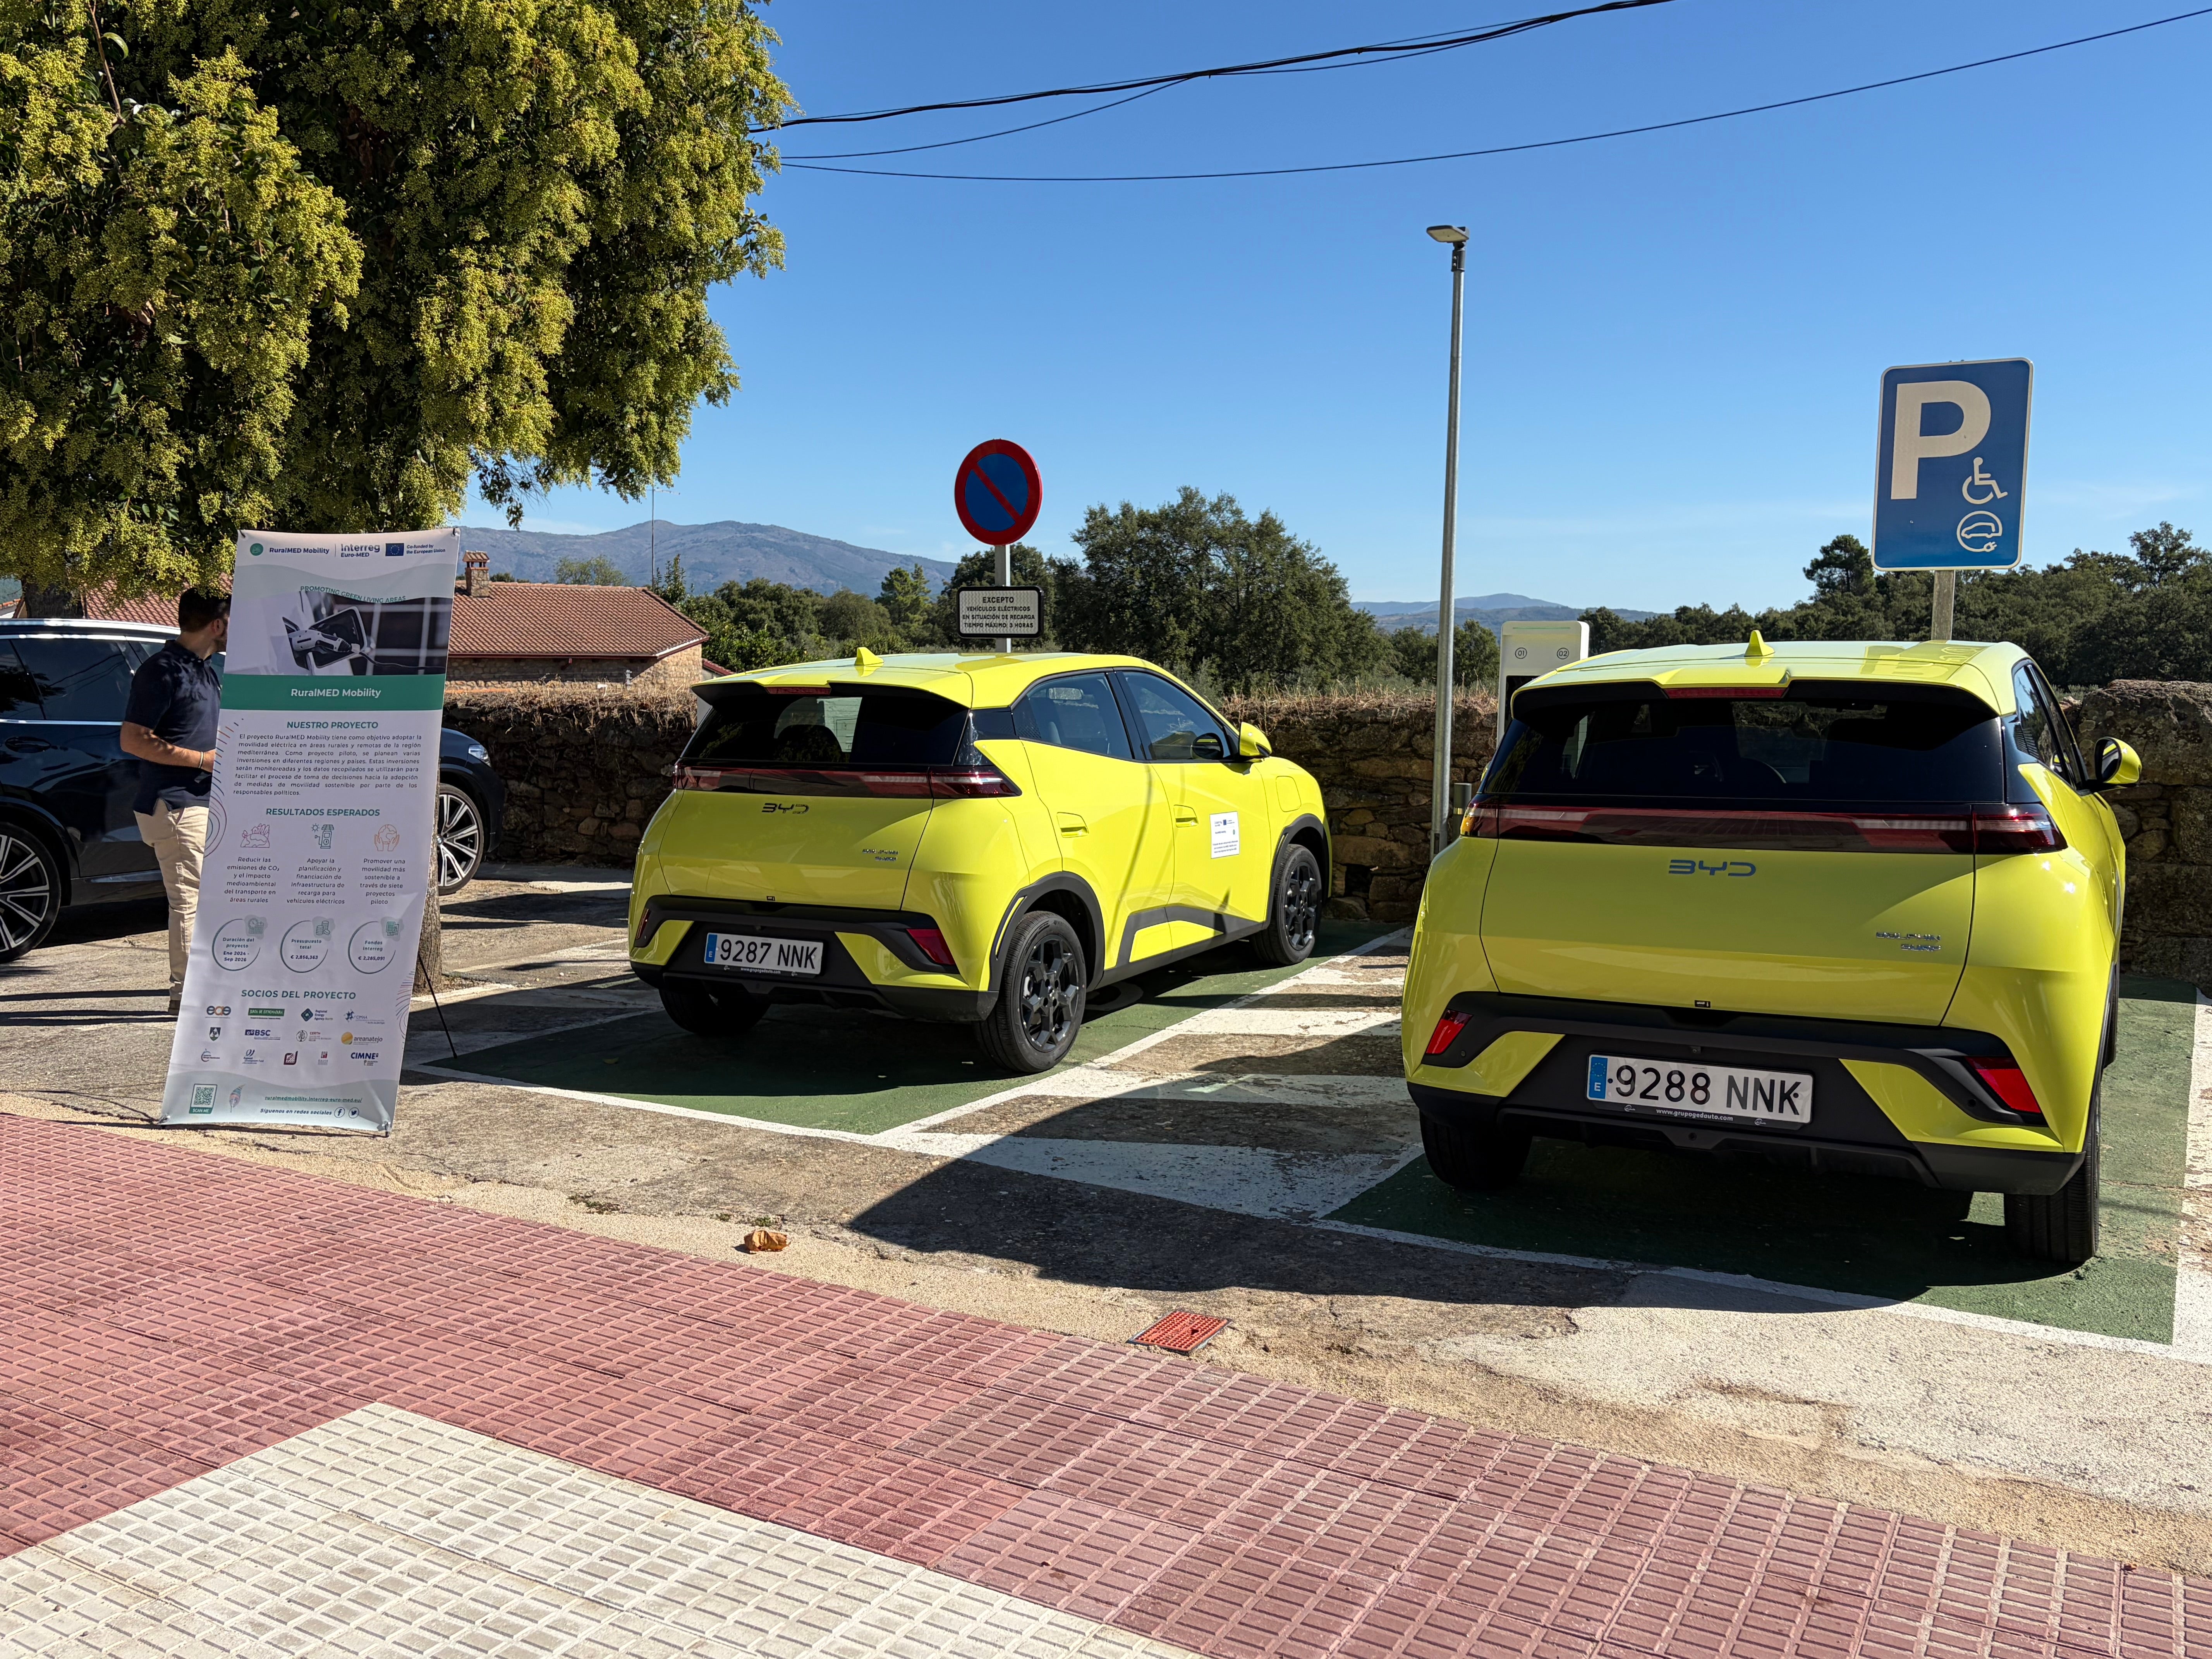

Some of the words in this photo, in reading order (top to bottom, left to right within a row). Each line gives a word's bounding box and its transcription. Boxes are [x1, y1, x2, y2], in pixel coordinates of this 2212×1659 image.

[1891, 380, 1991, 500] P
[341, 544, 380, 553] Interreg
[301, 586, 340, 595] PROMOTING
[341, 591, 362, 601] GREEN
[291, 688, 339, 697] RuralMED
[342, 688, 381, 698] Mobility
[762, 803, 809, 814] BYD
[1668, 859, 1757, 877] BYD
[720, 939, 771, 964] 9287
[777, 944, 817, 969] NNK
[1594, 1082, 1601, 1091] E
[1616, 1065, 1711, 1105] 9288
[1726, 1075, 1801, 1115] NNK
[1656, 1109, 1733, 1121] www.grupogedauto.com
